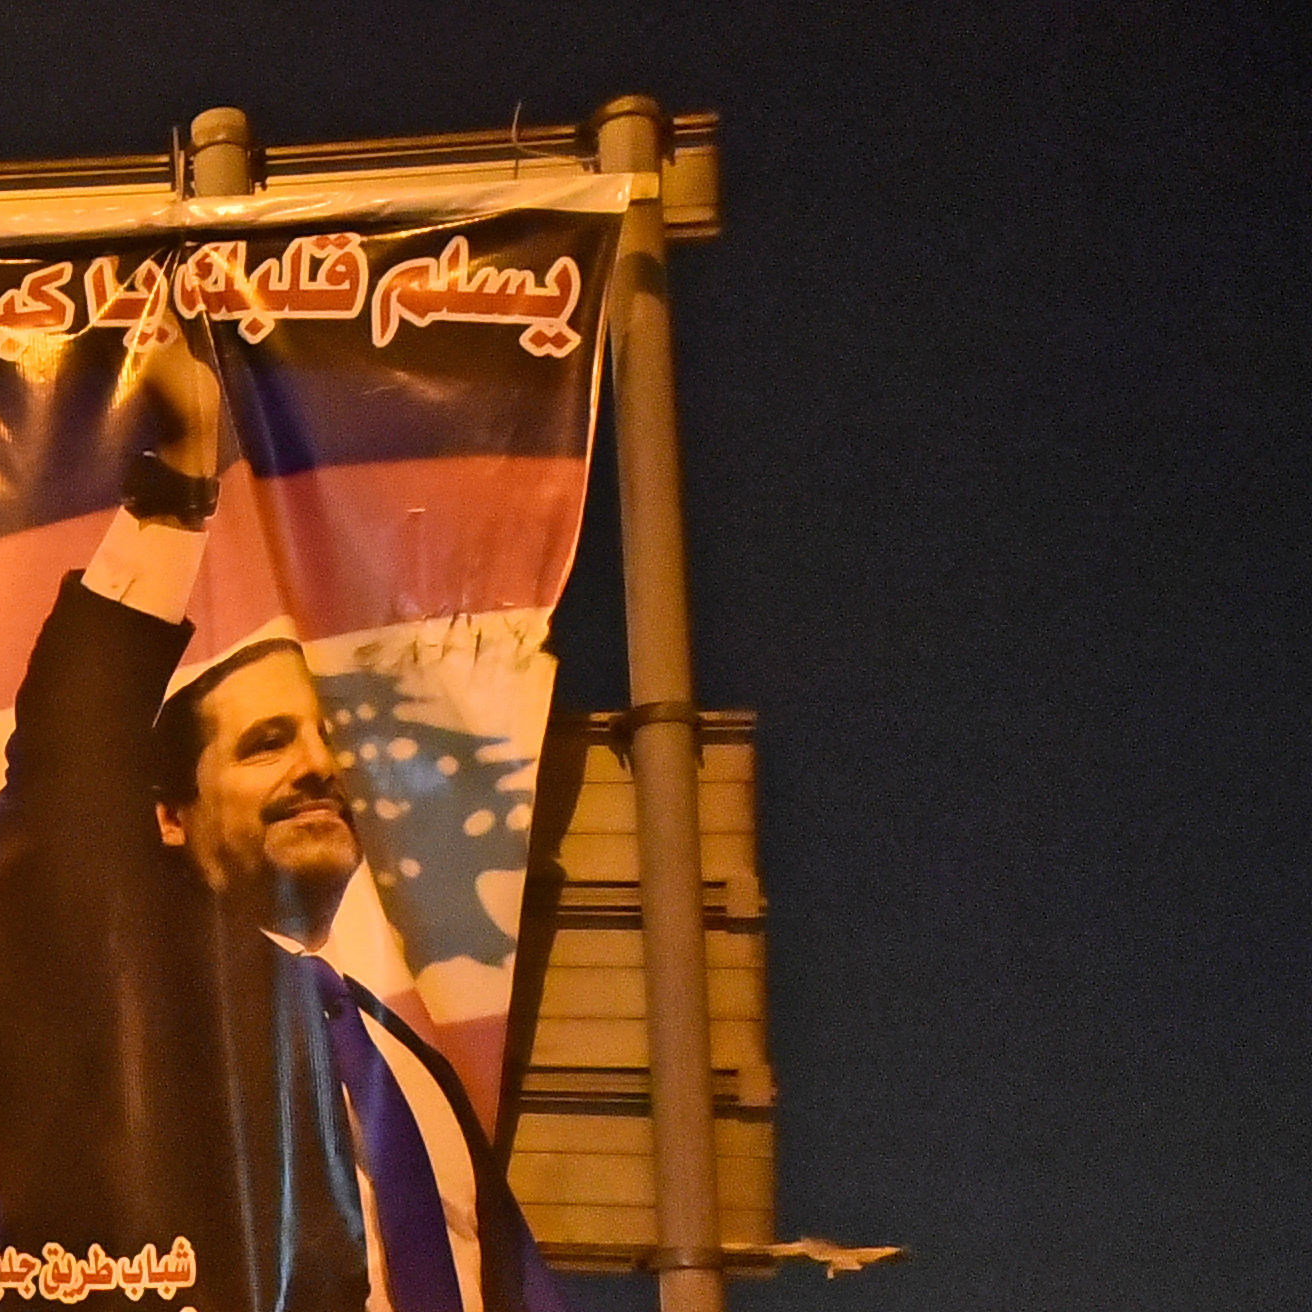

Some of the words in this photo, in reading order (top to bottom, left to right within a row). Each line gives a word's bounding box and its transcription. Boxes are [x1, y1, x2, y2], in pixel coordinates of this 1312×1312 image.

[85, 256, 174, 352] يا
[372, 236, 581, 358] يسلم
[40, 1242, 118, 1304] طريق
[117, 1236, 196, 1301] شباب
